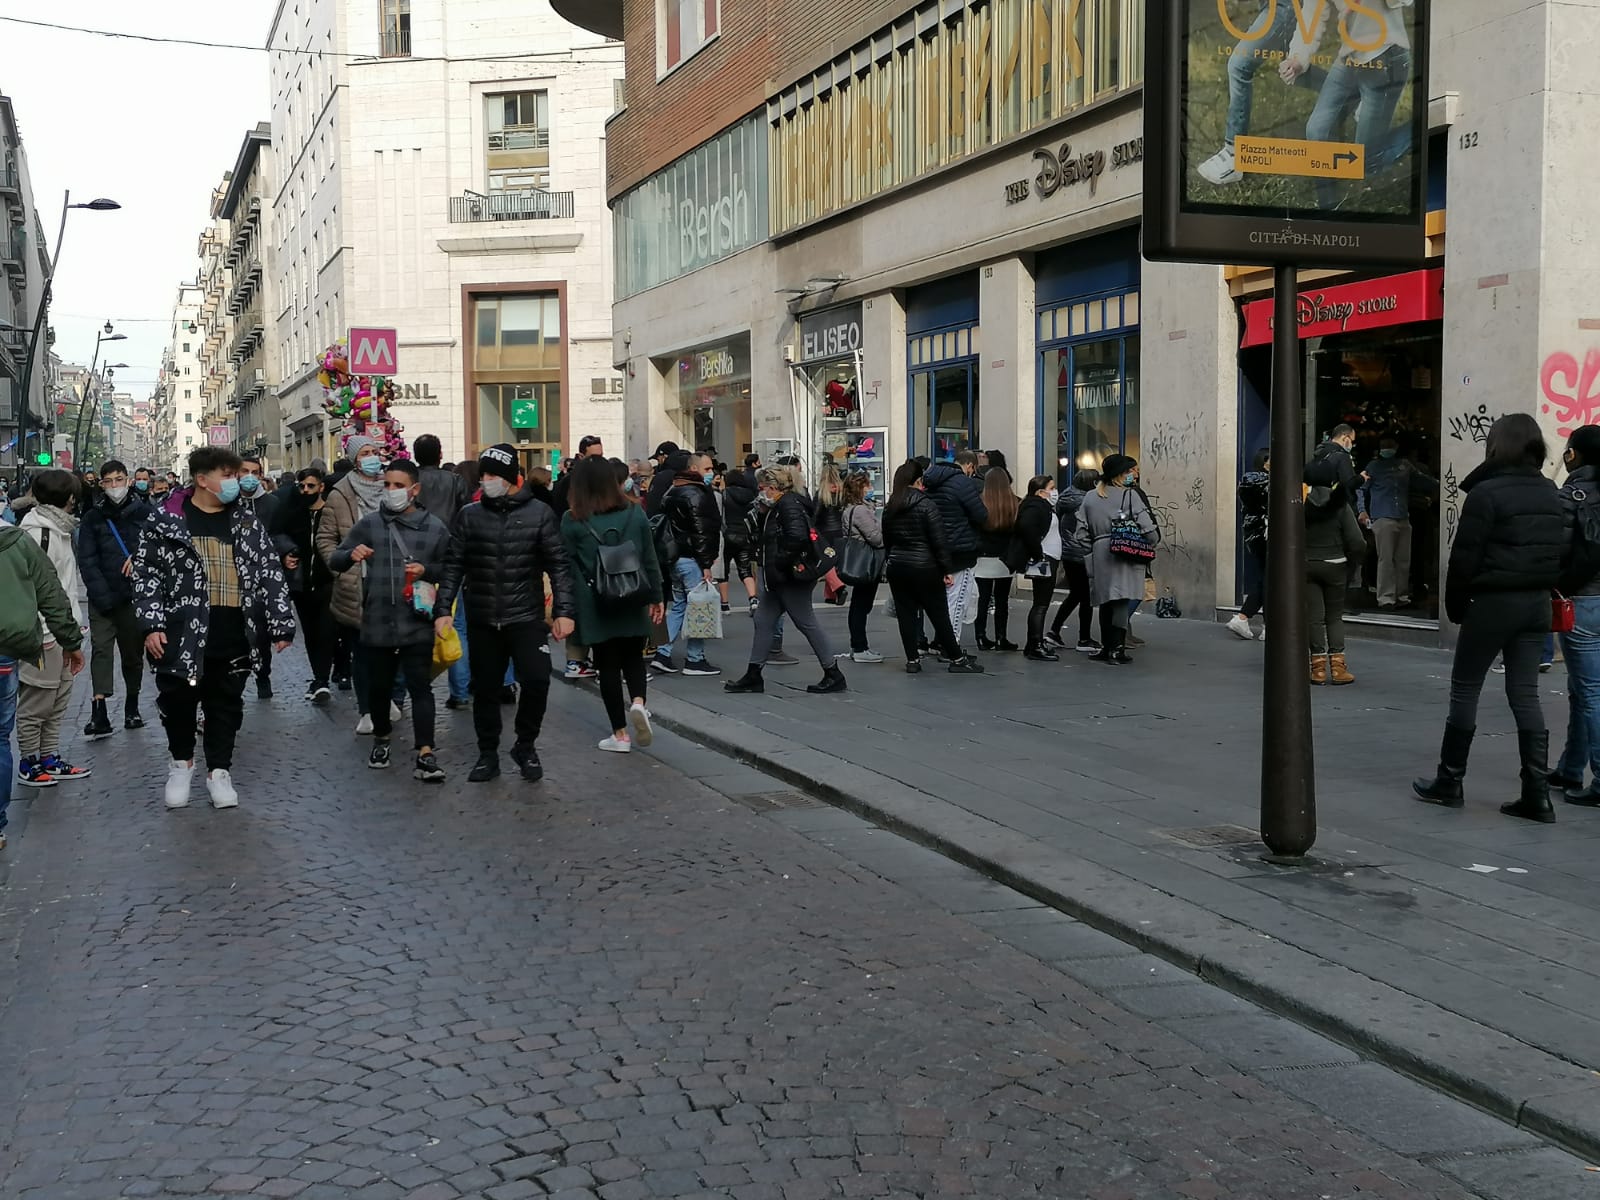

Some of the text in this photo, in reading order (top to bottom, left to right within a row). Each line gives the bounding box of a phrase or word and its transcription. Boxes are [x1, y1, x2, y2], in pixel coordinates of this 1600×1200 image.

[1240, 144, 1307, 157] Piazza Matteotti
[1459, 131, 1479, 150] 132
[1240, 155, 1272, 166] NAPOLI
[1005, 179, 1030, 202] THE
[1293, 234, 1307, 245] DI
[1312, 234, 1360, 248] NAPOLI
[1358, 294, 1397, 315] STORE
[354, 337, 393, 366] M
[803, 322, 860, 360] ELISEO
[701, 351, 734, 380] Bershka
